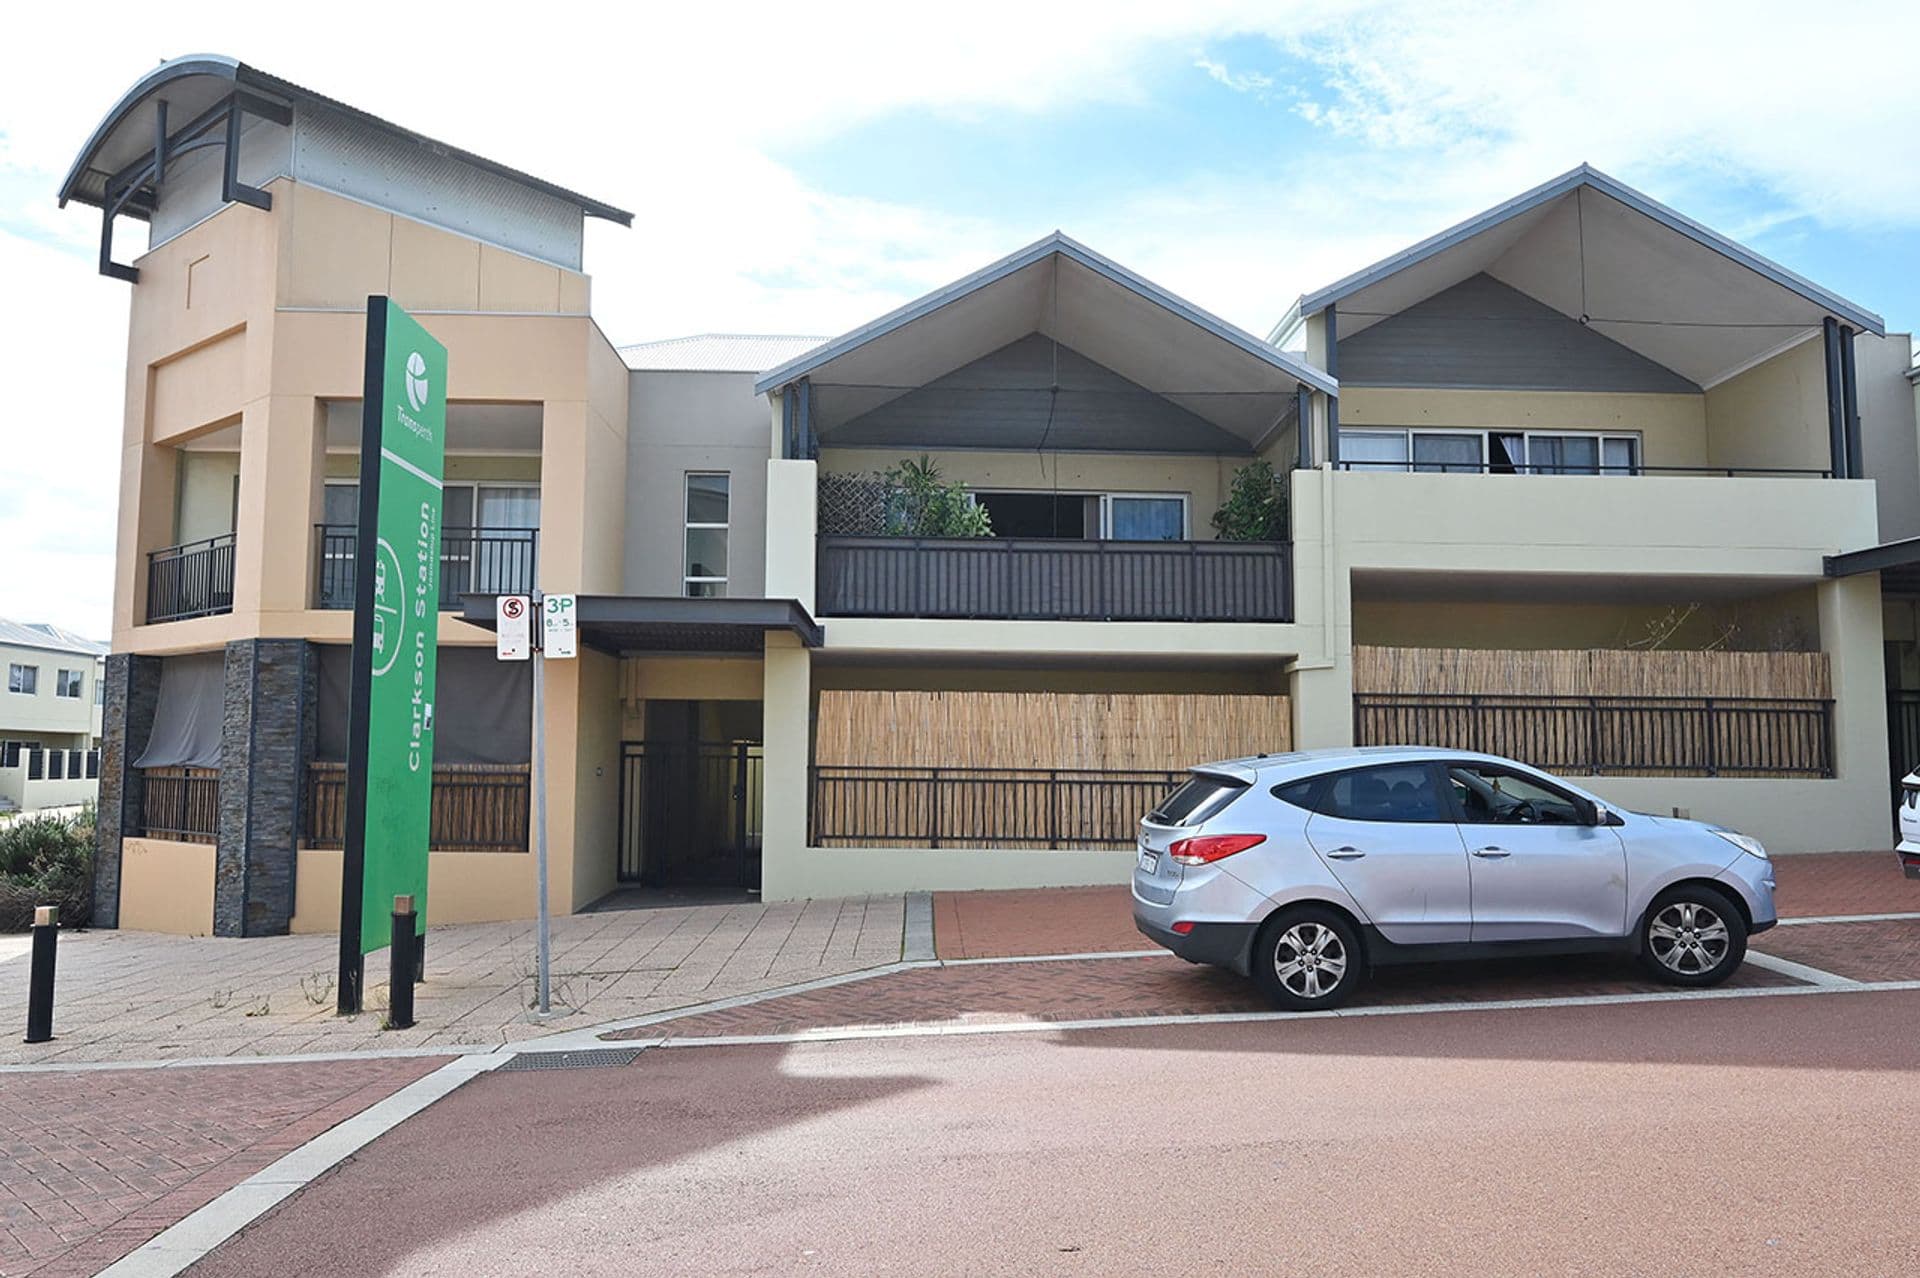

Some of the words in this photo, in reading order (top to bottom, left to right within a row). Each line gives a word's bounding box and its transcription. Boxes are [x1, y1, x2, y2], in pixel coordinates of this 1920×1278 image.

[415, 502, 430, 618] Station
[547, 598, 573, 613] 3P
[409, 631, 424, 771] Clarkson
